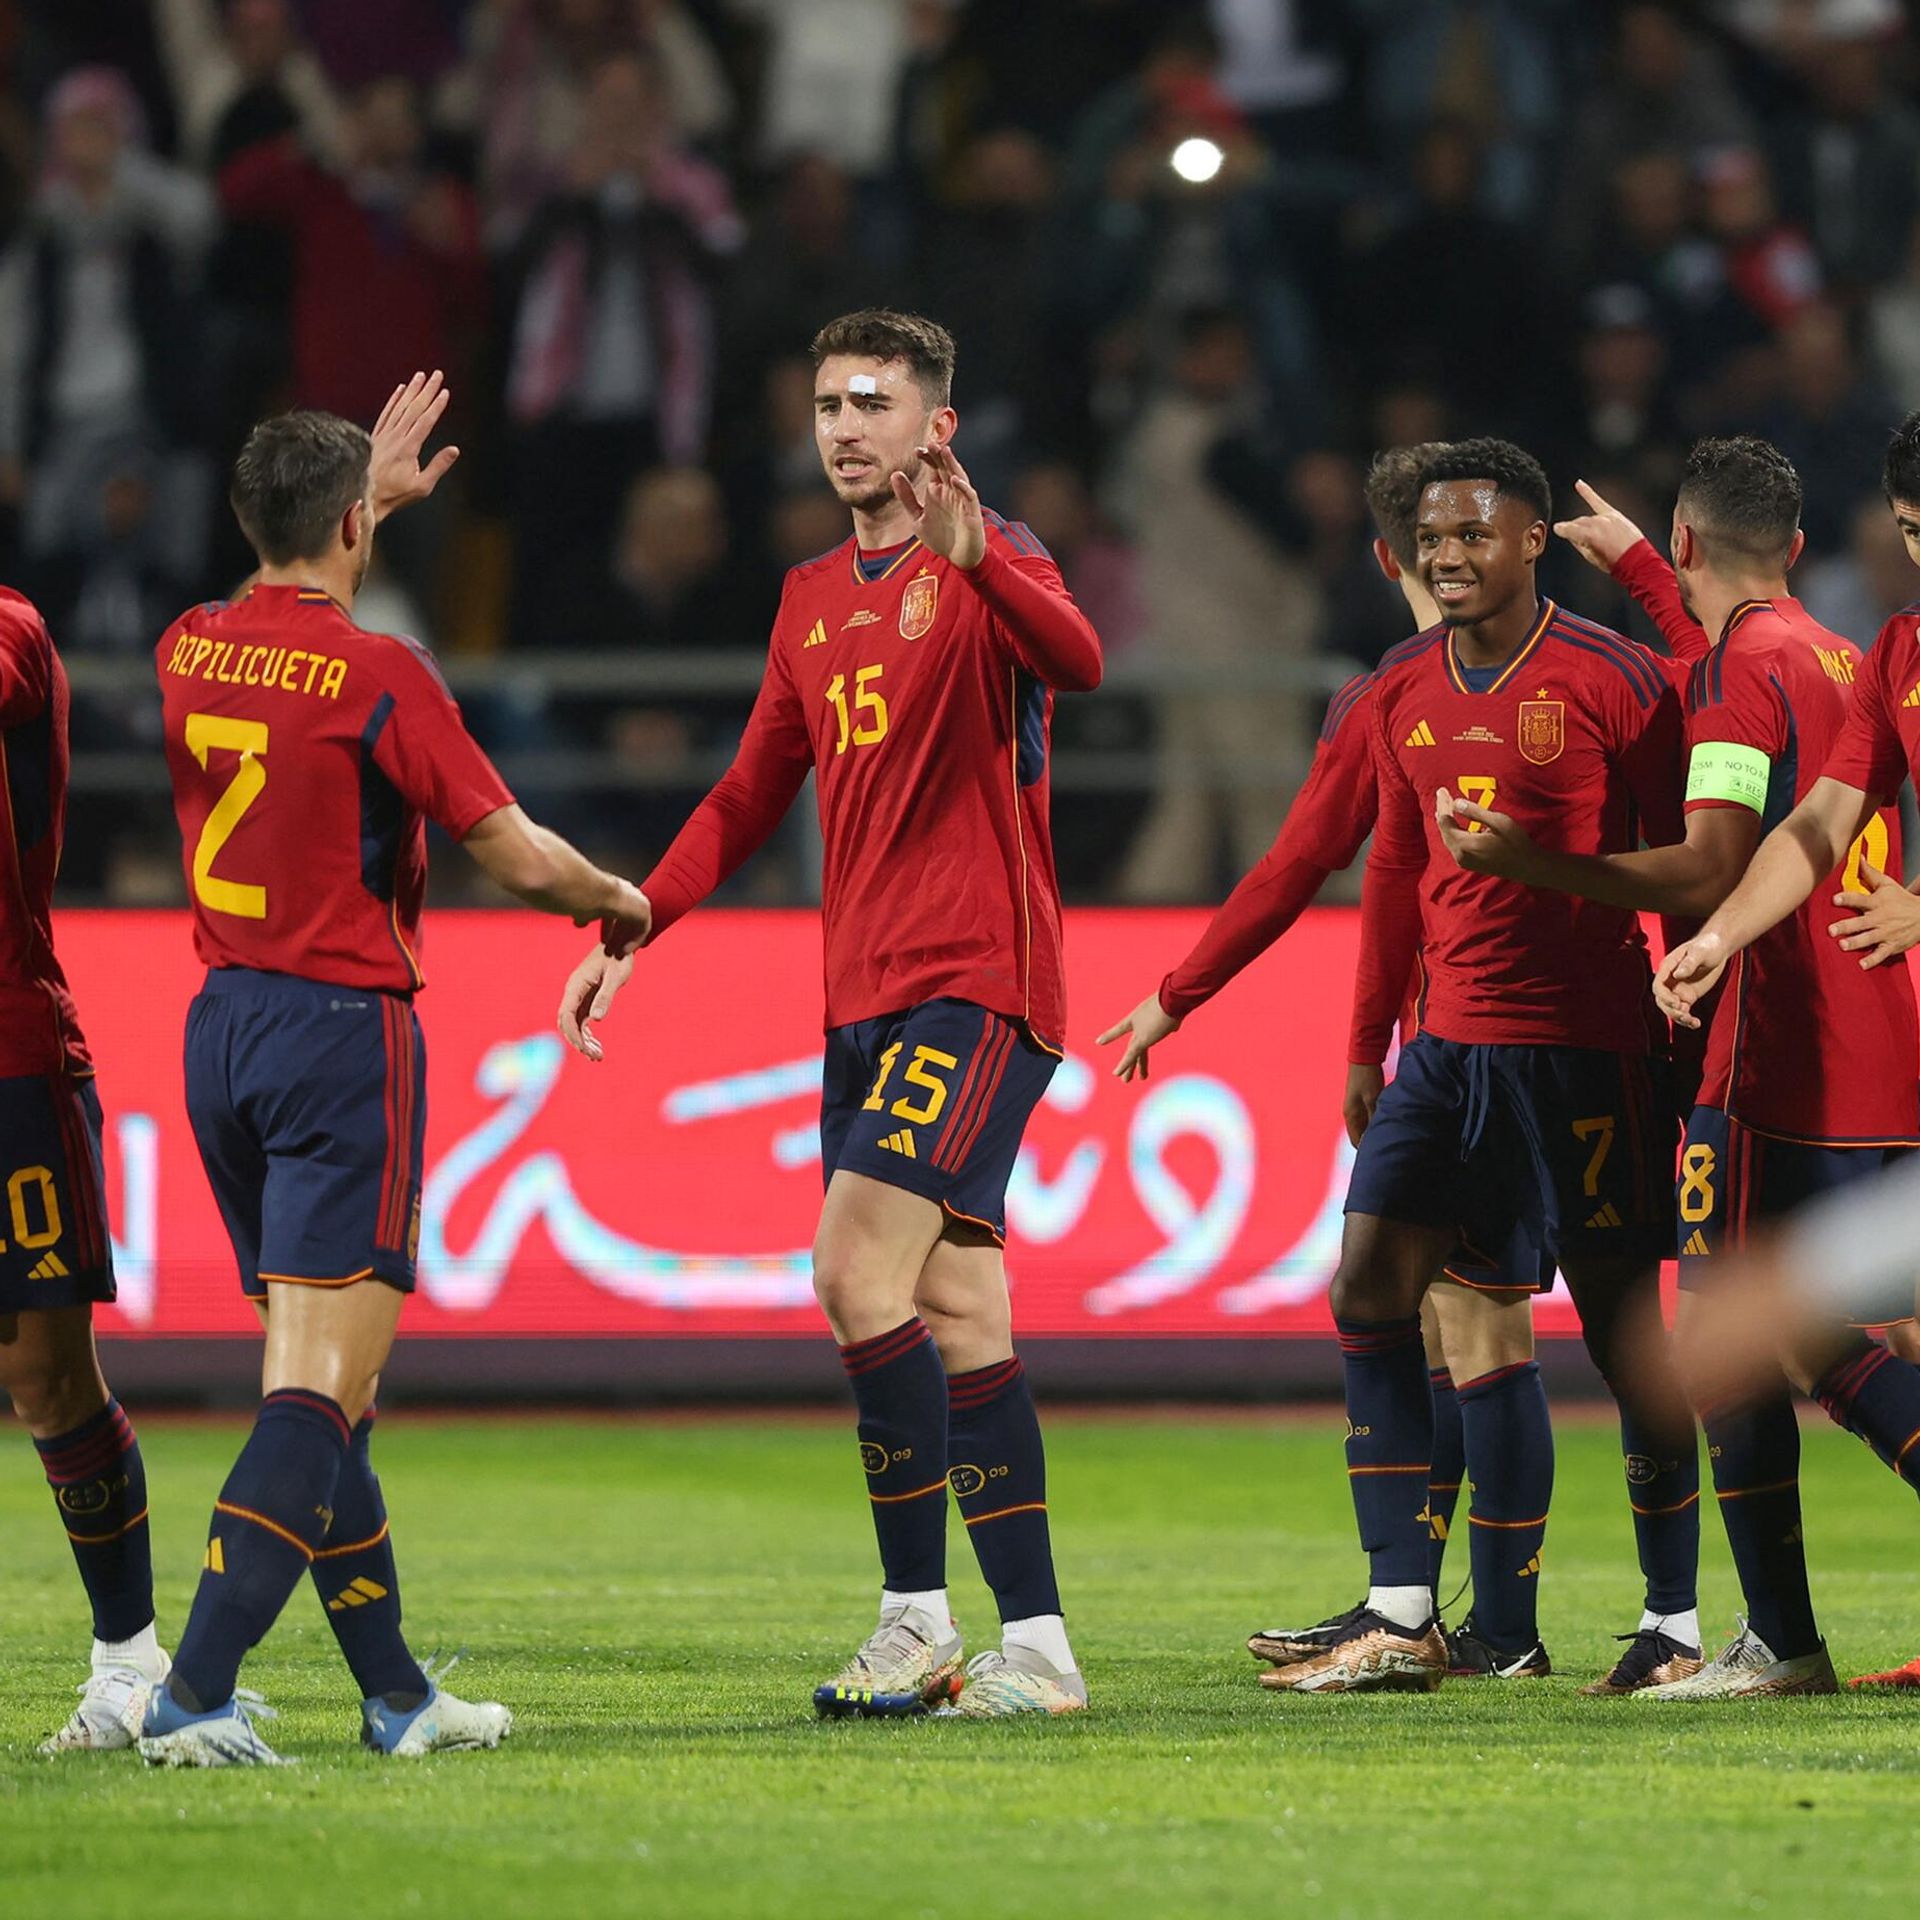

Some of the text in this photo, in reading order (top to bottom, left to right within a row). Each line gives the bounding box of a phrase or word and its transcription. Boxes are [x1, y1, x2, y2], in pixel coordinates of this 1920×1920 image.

[167, 633, 347, 699] AZPILICUETA
[825, 664, 888, 755] 15
[1457, 776, 1496, 832] 7
[1725, 761, 1742, 771] NO
[185, 713, 268, 919] 2
[862, 1042, 957, 1125] 15
[1572, 1115, 1614, 1196] 7
[1681, 1144, 1715, 1222] 8
[0, 1165, 62, 1253] 0
